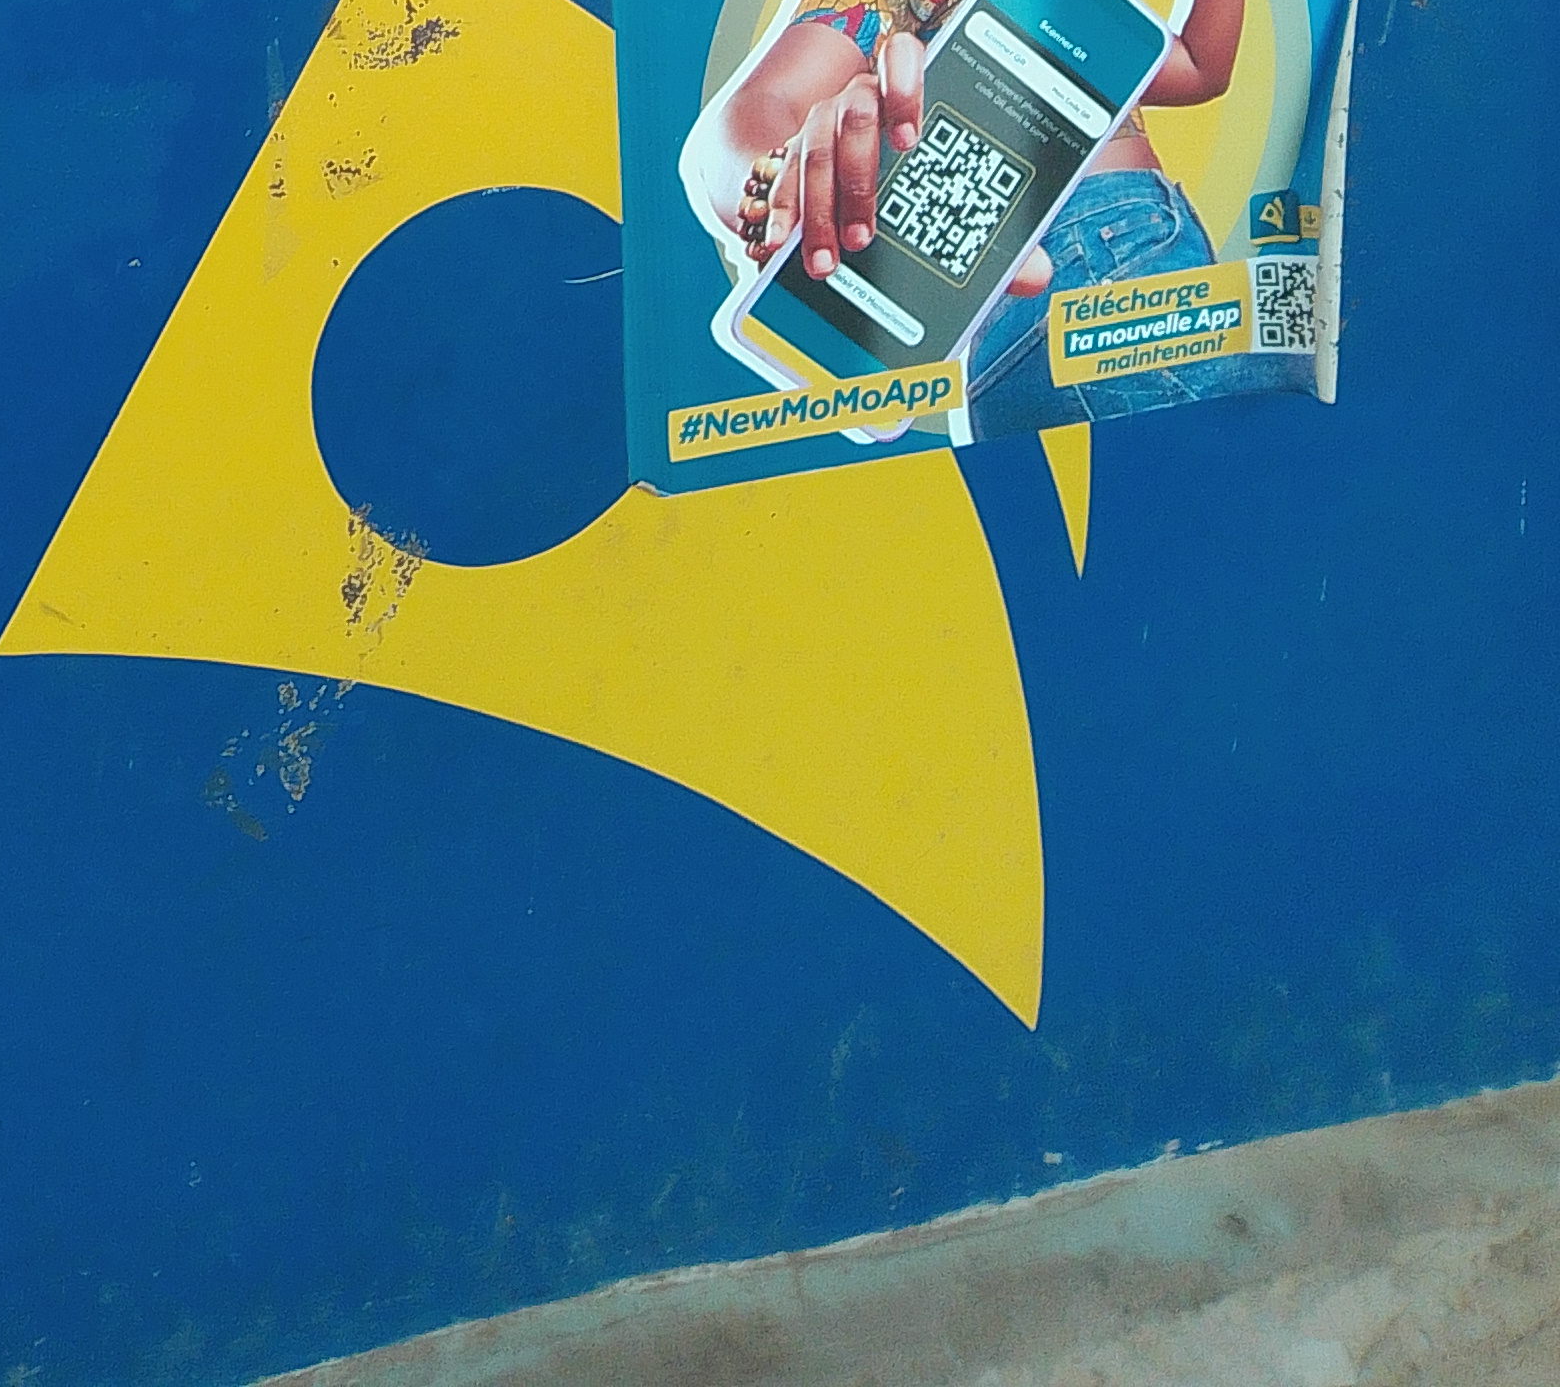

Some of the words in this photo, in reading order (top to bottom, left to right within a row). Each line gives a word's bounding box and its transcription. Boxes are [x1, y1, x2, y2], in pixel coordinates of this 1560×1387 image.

[1060, 280, 1211, 325] Télécharge
[1069, 332, 1093, 353] ta
[1097, 313, 1192, 348] nouvelle
[1193, 307, 1240, 331] App
[1095, 332, 1227, 375] maintenant
[678, 373, 951, 446] #NewMoMoApp
